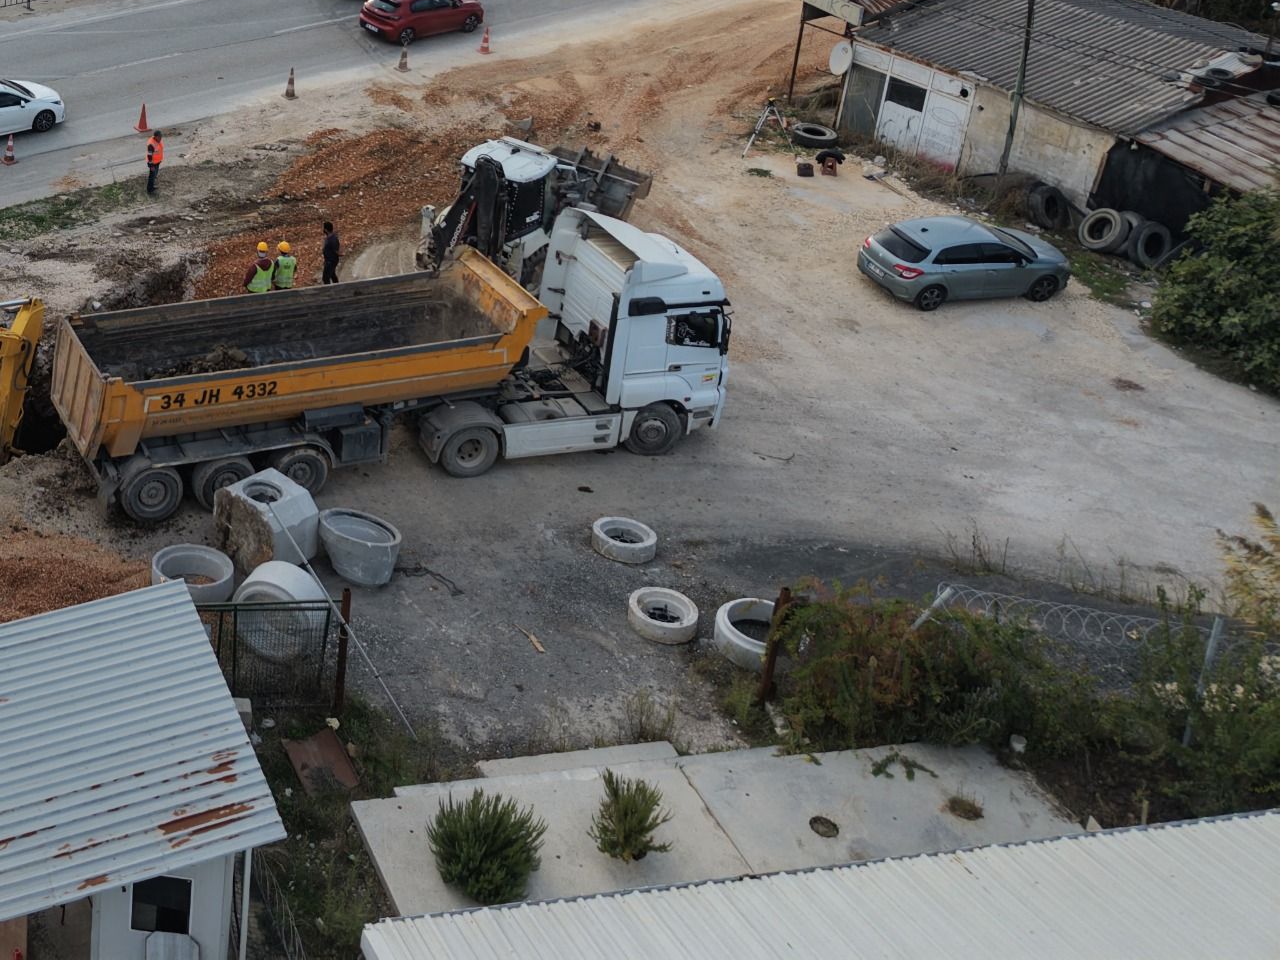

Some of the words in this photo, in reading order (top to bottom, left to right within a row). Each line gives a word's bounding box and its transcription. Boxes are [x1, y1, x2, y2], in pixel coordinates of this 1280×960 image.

[161, 393, 185, 410] 34
[194, 388, 220, 405] JH
[232, 381, 277, 400] 4332
